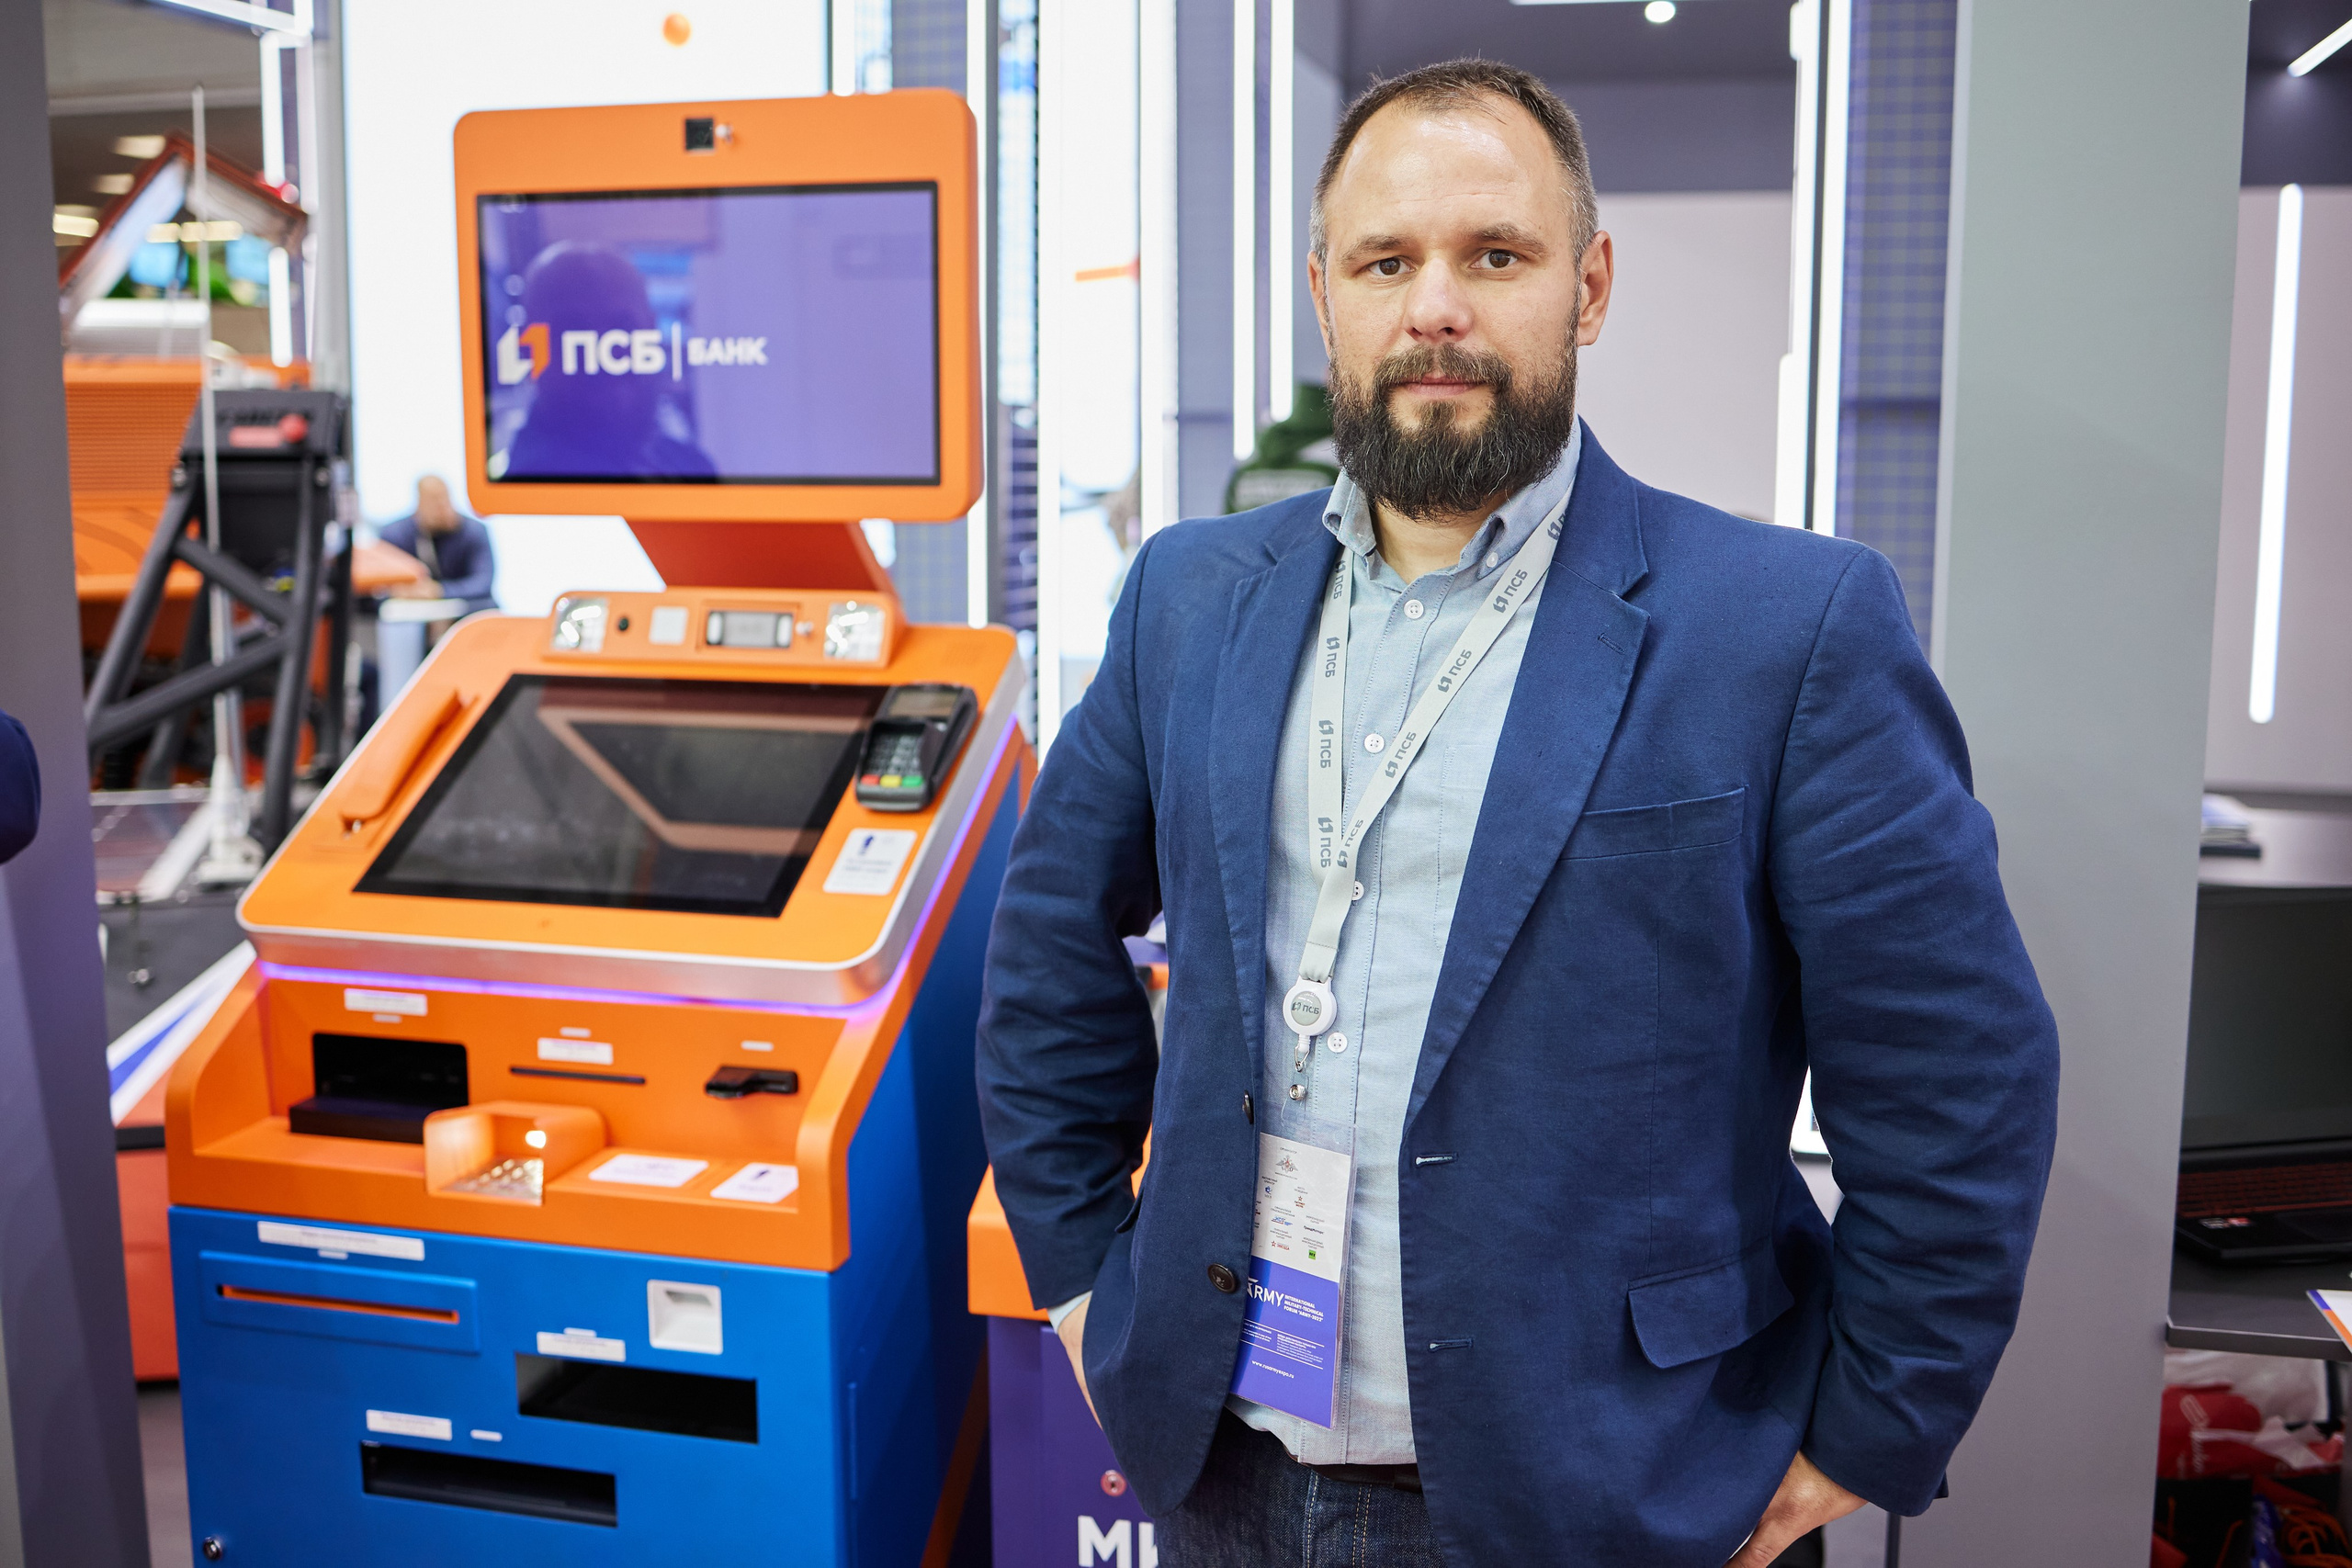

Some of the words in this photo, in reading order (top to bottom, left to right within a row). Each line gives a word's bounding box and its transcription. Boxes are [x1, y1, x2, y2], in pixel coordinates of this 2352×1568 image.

[561, 329, 666, 375] ПСБ
[687, 336, 769, 367] БАНК
[1333, 574, 1343, 600] ПСБ
[1504, 570, 1528, 597] ПСБ
[1325, 652, 1337, 678] ПСБ
[1448, 649, 1472, 676] ПСБ
[1320, 739, 1331, 769] ПСБ
[1395, 732, 1417, 760] ПСБ
[1344, 819, 1364, 847] ПСБ
[1320, 837, 1331, 868] ПСБ
[1302, 1004, 1319, 1014] ПСБ
[1284, 1294, 1315, 1308] INTERNATIONAL
